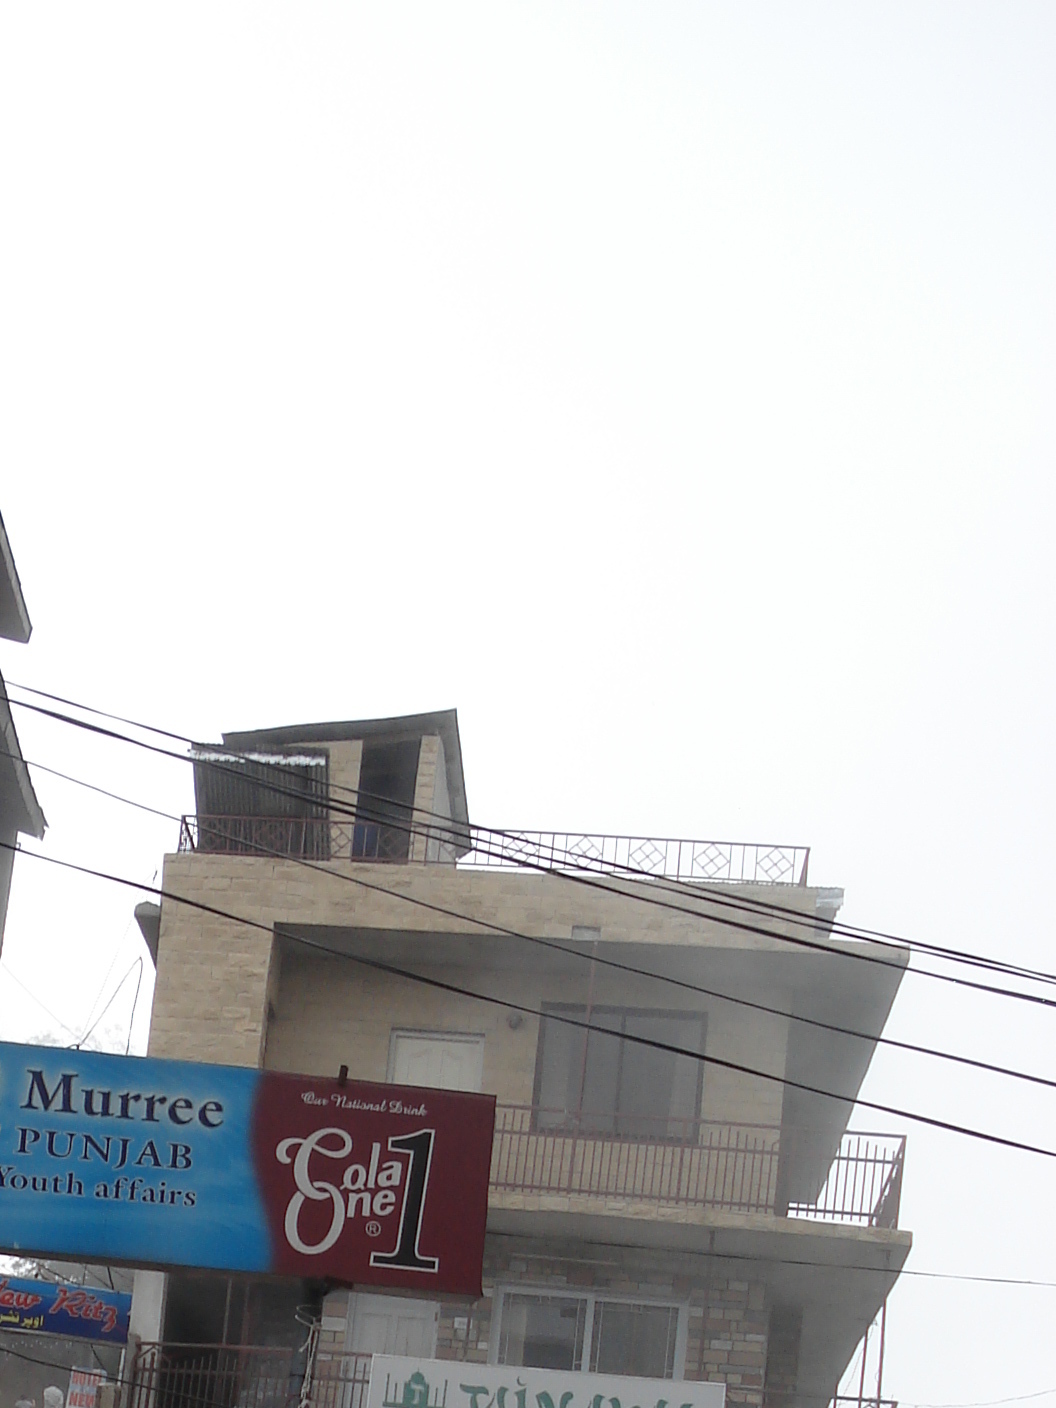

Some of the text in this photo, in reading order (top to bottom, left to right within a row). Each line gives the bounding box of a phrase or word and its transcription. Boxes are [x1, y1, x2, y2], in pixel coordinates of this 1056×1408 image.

[20, 1068, 225, 1128] Murree
[331, 1094, 387, 1113] National
[389, 1100, 428, 1116] Drink
[15, 1127, 193, 1170] PUNJAB
[276, 1127, 402, 1200] Cola
[94, 1175, 197, 1207] affairs
[369, 1128, 439, 1273] 1
[284, 1181, 396, 1255] One
[49, 1287, 119, 1332] Ritz
